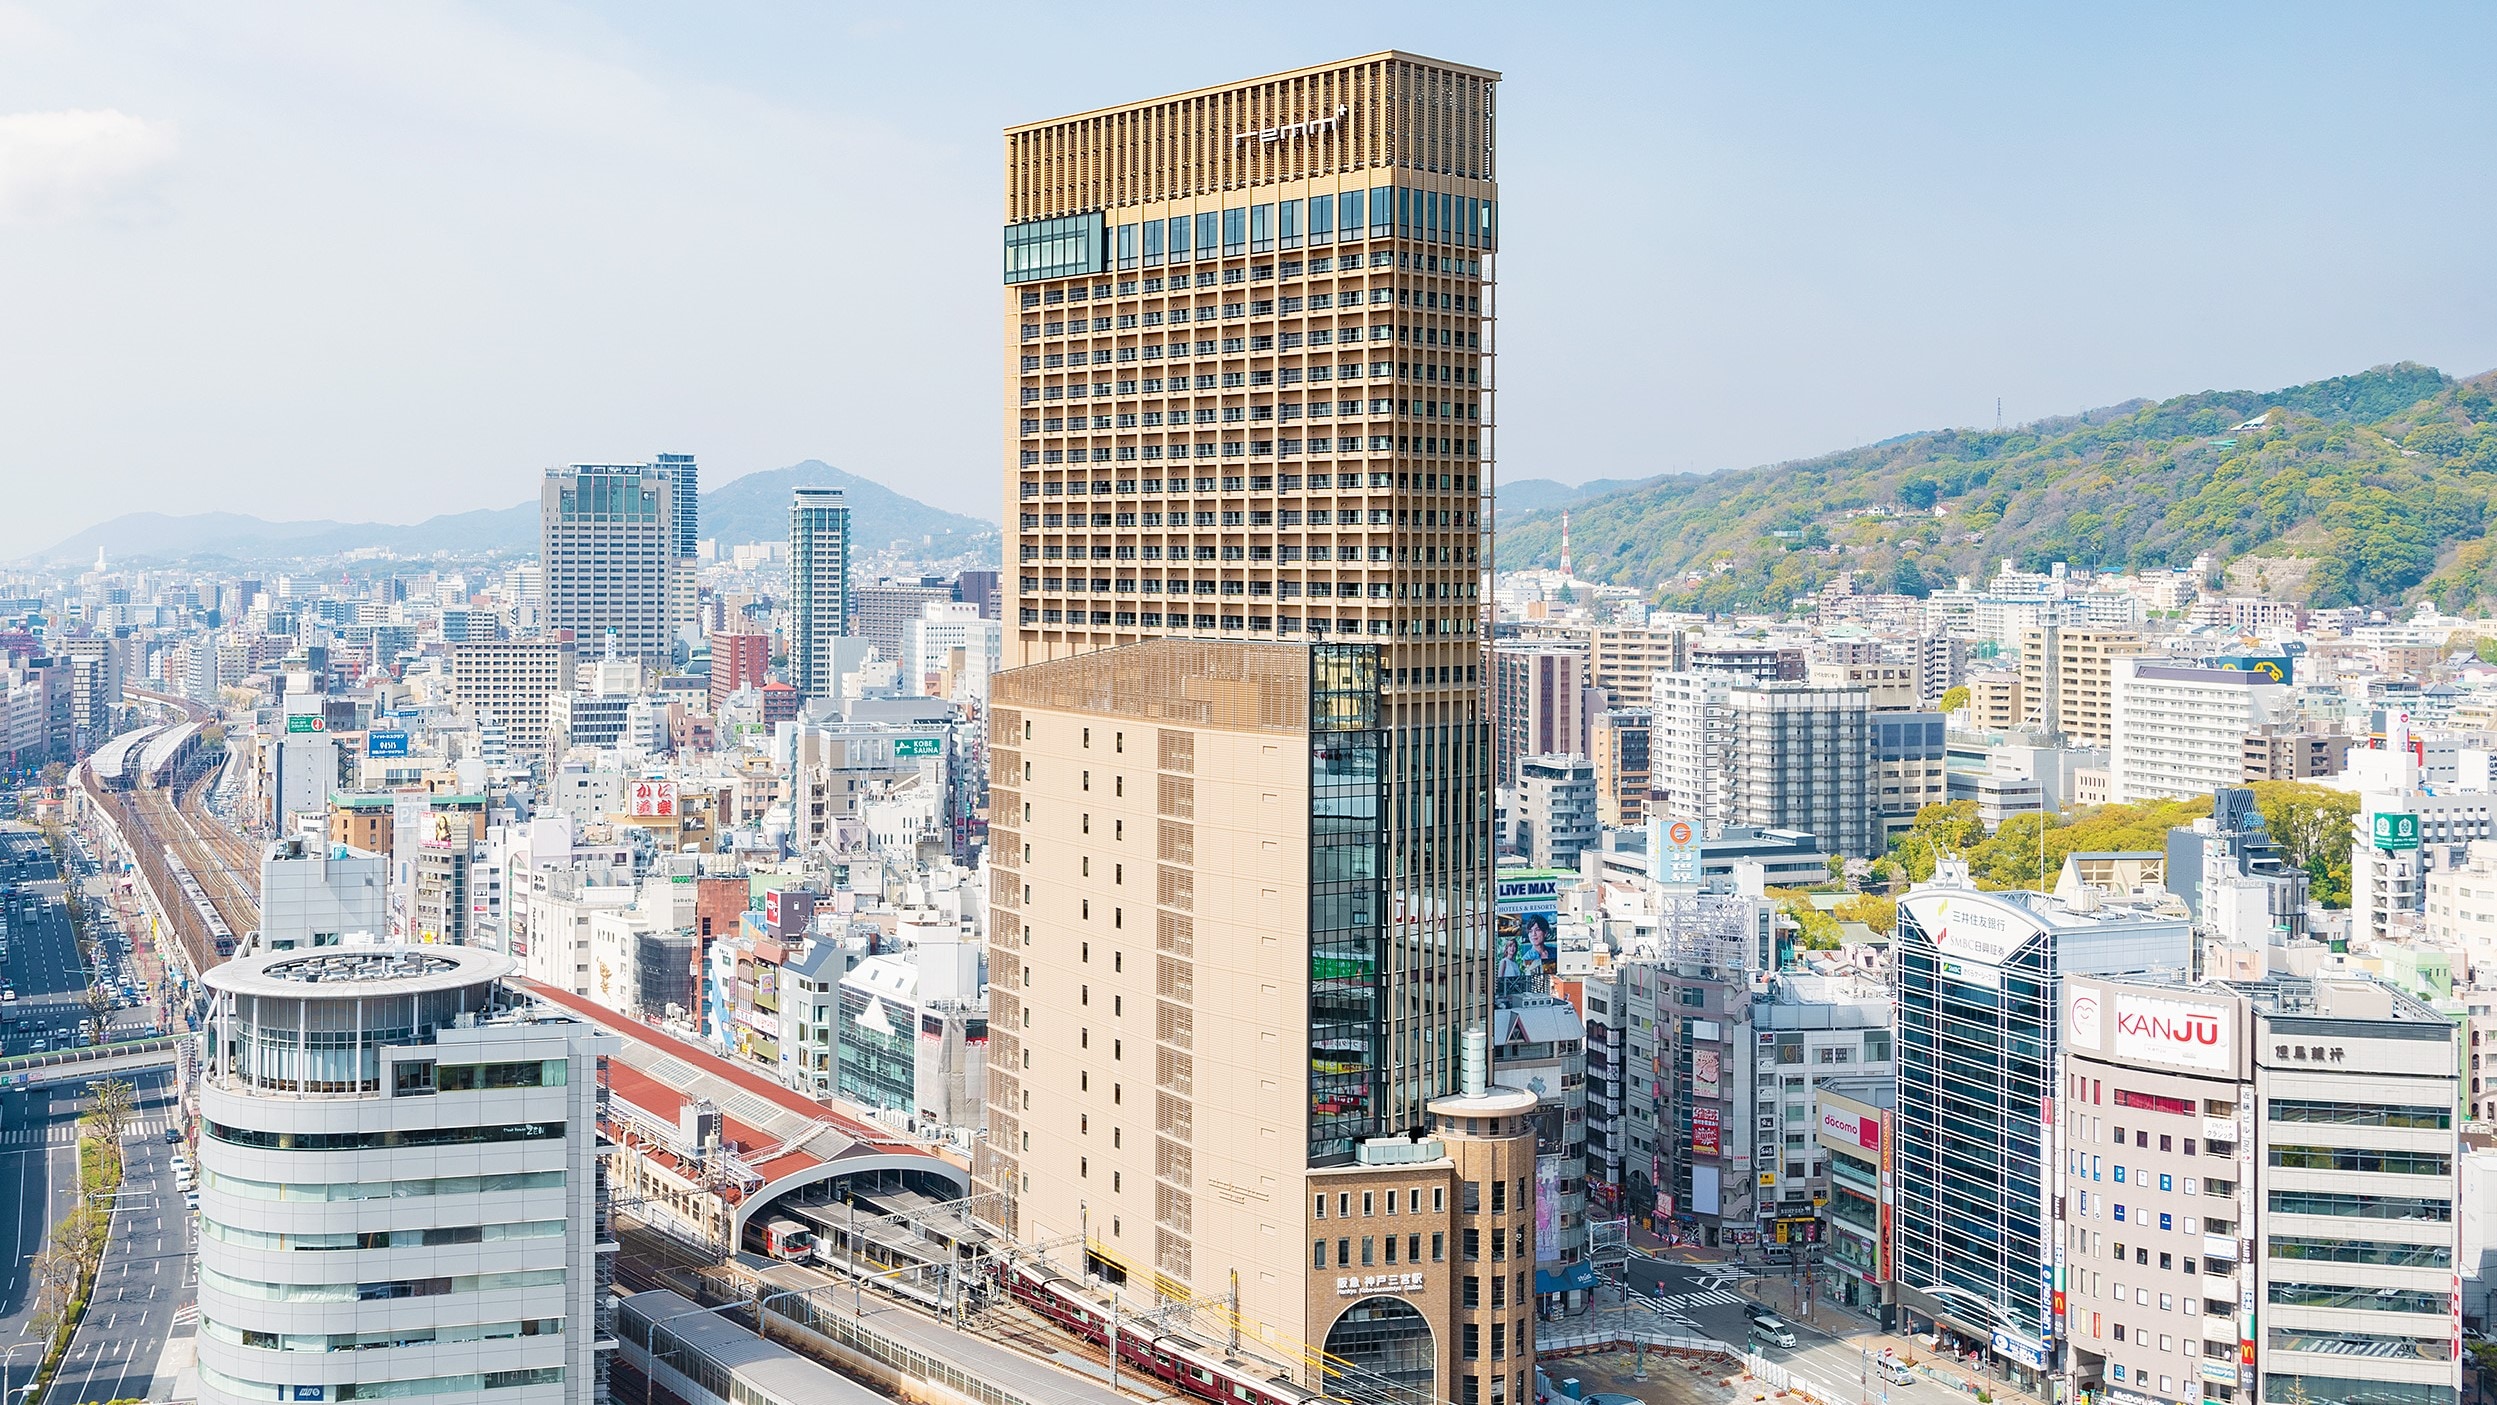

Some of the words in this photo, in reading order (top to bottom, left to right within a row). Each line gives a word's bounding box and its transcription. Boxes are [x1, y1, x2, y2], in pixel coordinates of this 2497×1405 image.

[636, 783, 672, 798] かに
[1527, 882, 1556, 895] MAX
[1499, 905, 1523, 913] HOTELS
[1952, 910, 2006, 932] 三井住友銀行
[1950, 935, 2006, 957] SMBC日興証券
[2275, 1044, 2346, 1064] 但馬銀行
[1825, 1114, 1858, 1135] docomo
[1834, 1261, 1851, 1272] docomo
[1337, 1276, 1360, 1289] 阪急
[1364, 1273, 1423, 1287] 神戸三宮駅
